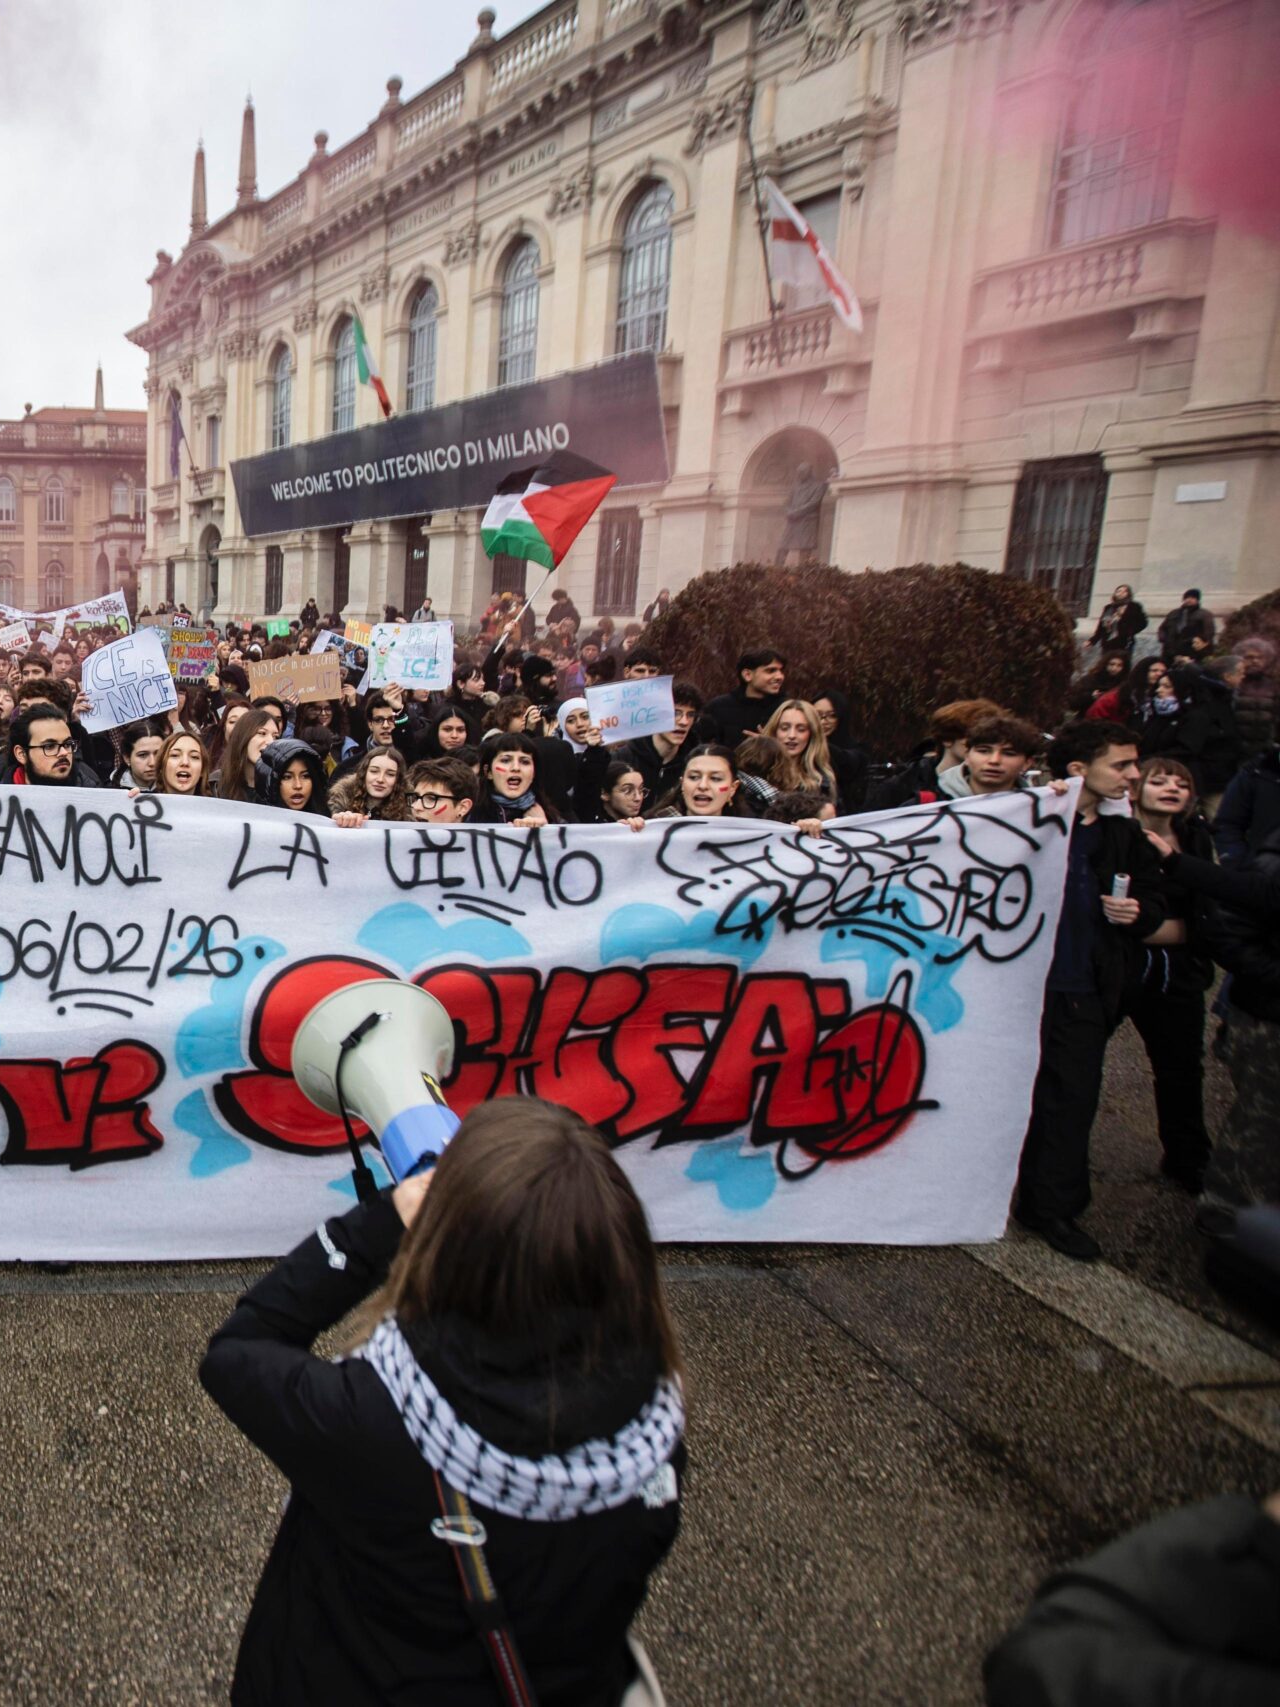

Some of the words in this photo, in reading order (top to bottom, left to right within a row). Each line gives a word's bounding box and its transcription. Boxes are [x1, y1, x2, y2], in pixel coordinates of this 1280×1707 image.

[508, 143, 556, 177] MILANO
[271, 475, 333, 501] WELCOME
[333, 468, 353, 490] TO
[356, 444, 462, 485] POLITECNICO
[465, 439, 484, 464] DI
[488, 422, 570, 462] MILANO
[347, 618, 360, 630] NO
[83, 639, 138, 695] ICE
[142, 660, 155, 676] IS
[253, 663, 268, 677] NO
[401, 657, 440, 680] ICE
[106, 673, 177, 724] NICE
[600, 715, 619, 729] NO
[630, 706, 658, 727] ICE
[228, 822, 330, 890] LA
